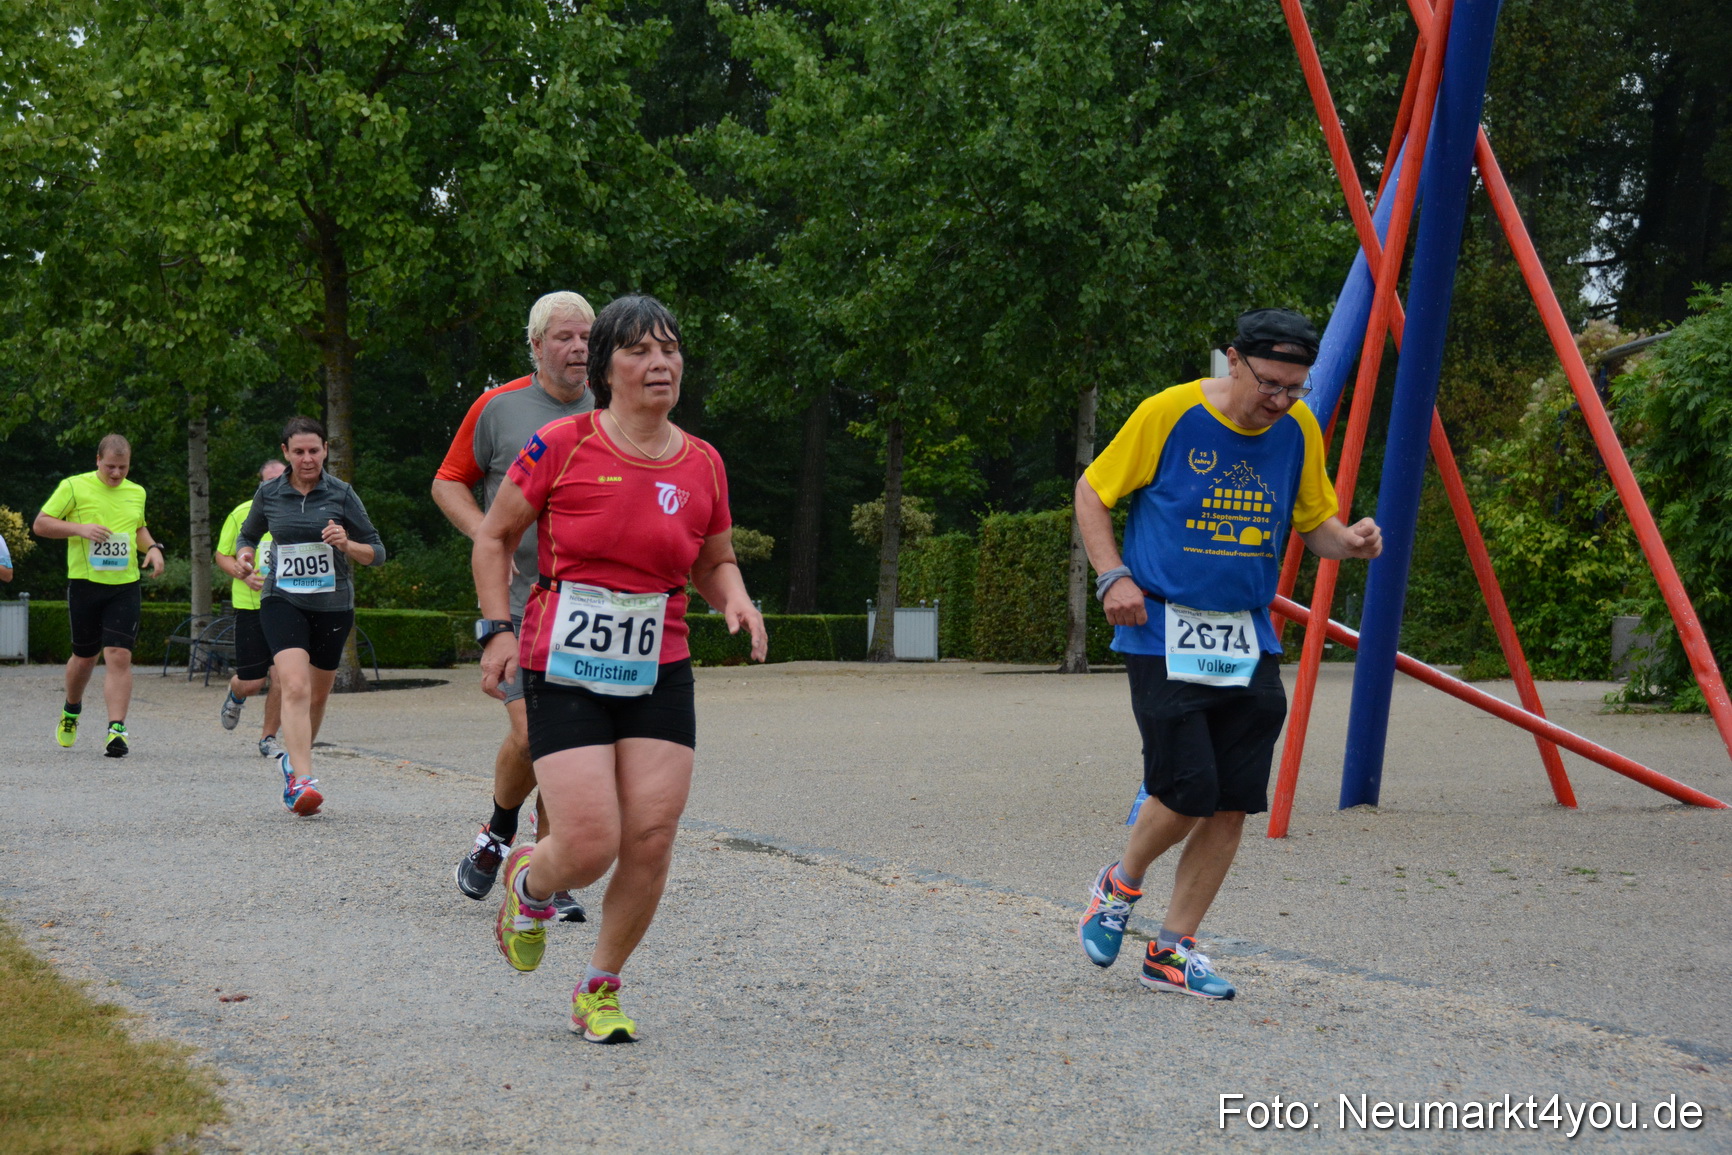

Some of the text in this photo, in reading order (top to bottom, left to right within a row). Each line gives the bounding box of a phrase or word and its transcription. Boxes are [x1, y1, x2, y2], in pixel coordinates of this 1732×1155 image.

[1252, 515, 1270, 523] 2014
[94, 542, 128, 556] 2333
[282, 554, 329, 577] 2095
[292, 578, 322, 587] Claudia
[564, 610, 657, 656] 2516
[1177, 618, 1251, 654] 2674
[555, 643, 560, 651] D
[574, 659, 638, 682] Christine
[1197, 658, 1237, 674] Volker
